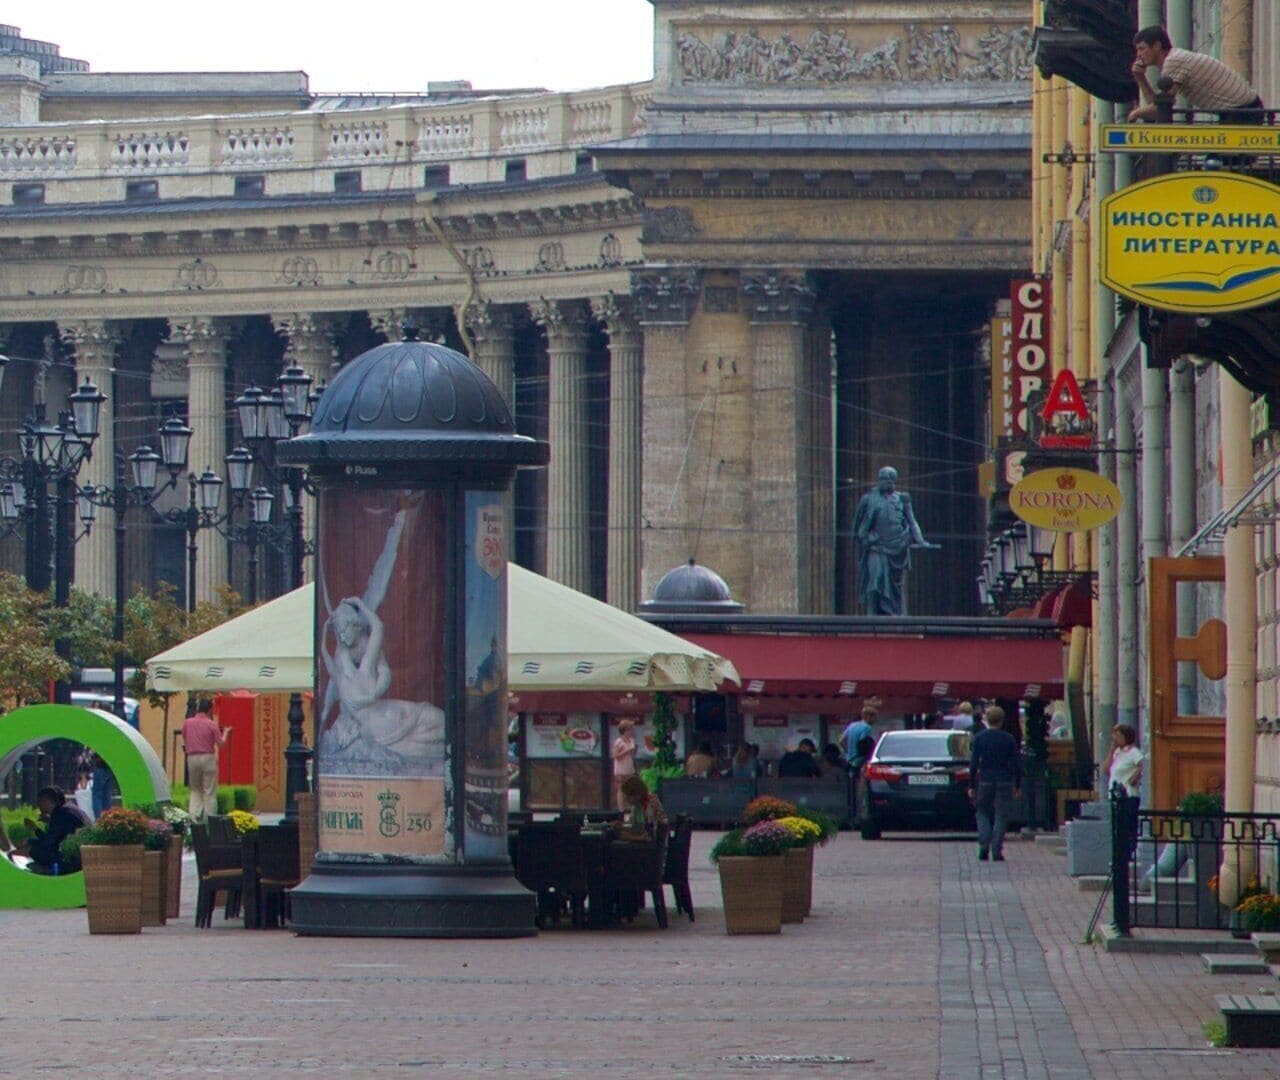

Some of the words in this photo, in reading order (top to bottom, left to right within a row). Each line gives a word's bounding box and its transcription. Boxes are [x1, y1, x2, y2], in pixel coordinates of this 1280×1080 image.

[1139, 131, 1227, 145] Книжный
[1239, 135, 1273, 146] дом
[1112, 211, 1278, 228] ИНОСТРАННА
[1123, 237, 1280, 255] ЛИТЕРАТУРА
[1019, 491, 1115, 511] KORONA
[406, 818, 433, 832] 250
